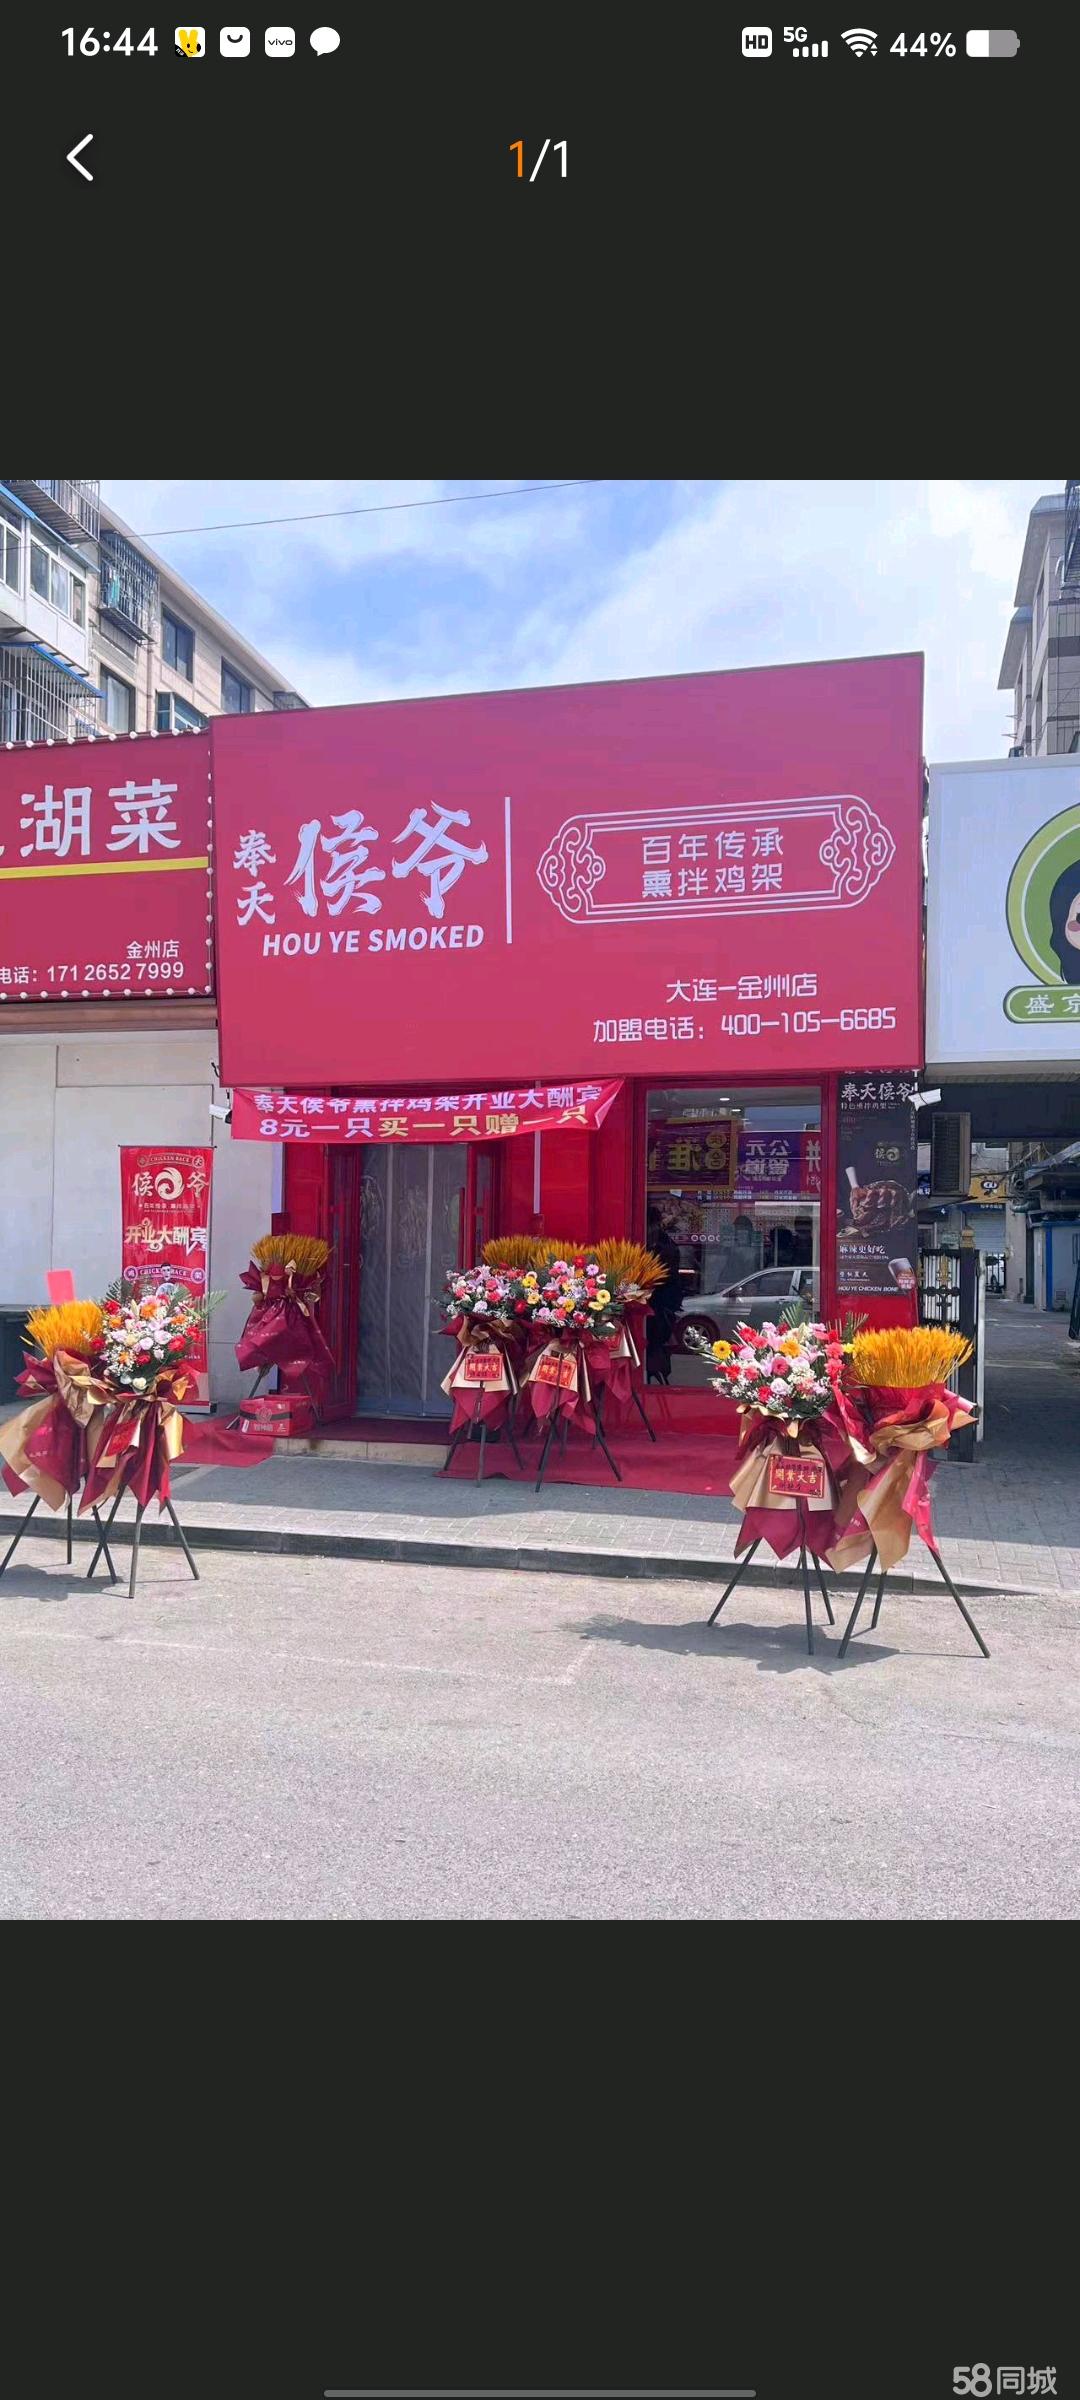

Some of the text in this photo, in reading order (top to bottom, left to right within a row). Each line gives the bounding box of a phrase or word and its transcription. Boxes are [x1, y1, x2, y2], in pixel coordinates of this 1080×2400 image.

[0, 778, 182, 858] 湖菜
[284, 800, 489, 919] 侯爷
[641, 827, 785, 866] 百年传承
[233, 828, 277, 927] 奉天
[641, 861, 784, 899] 熏拌鸡架
[126, 939, 180, 960] 金州店
[262, 923, 485, 957] HOU YE SMOKED
[84, 963, 131, 982] 2652
[136, 961, 184, 981] 7999
